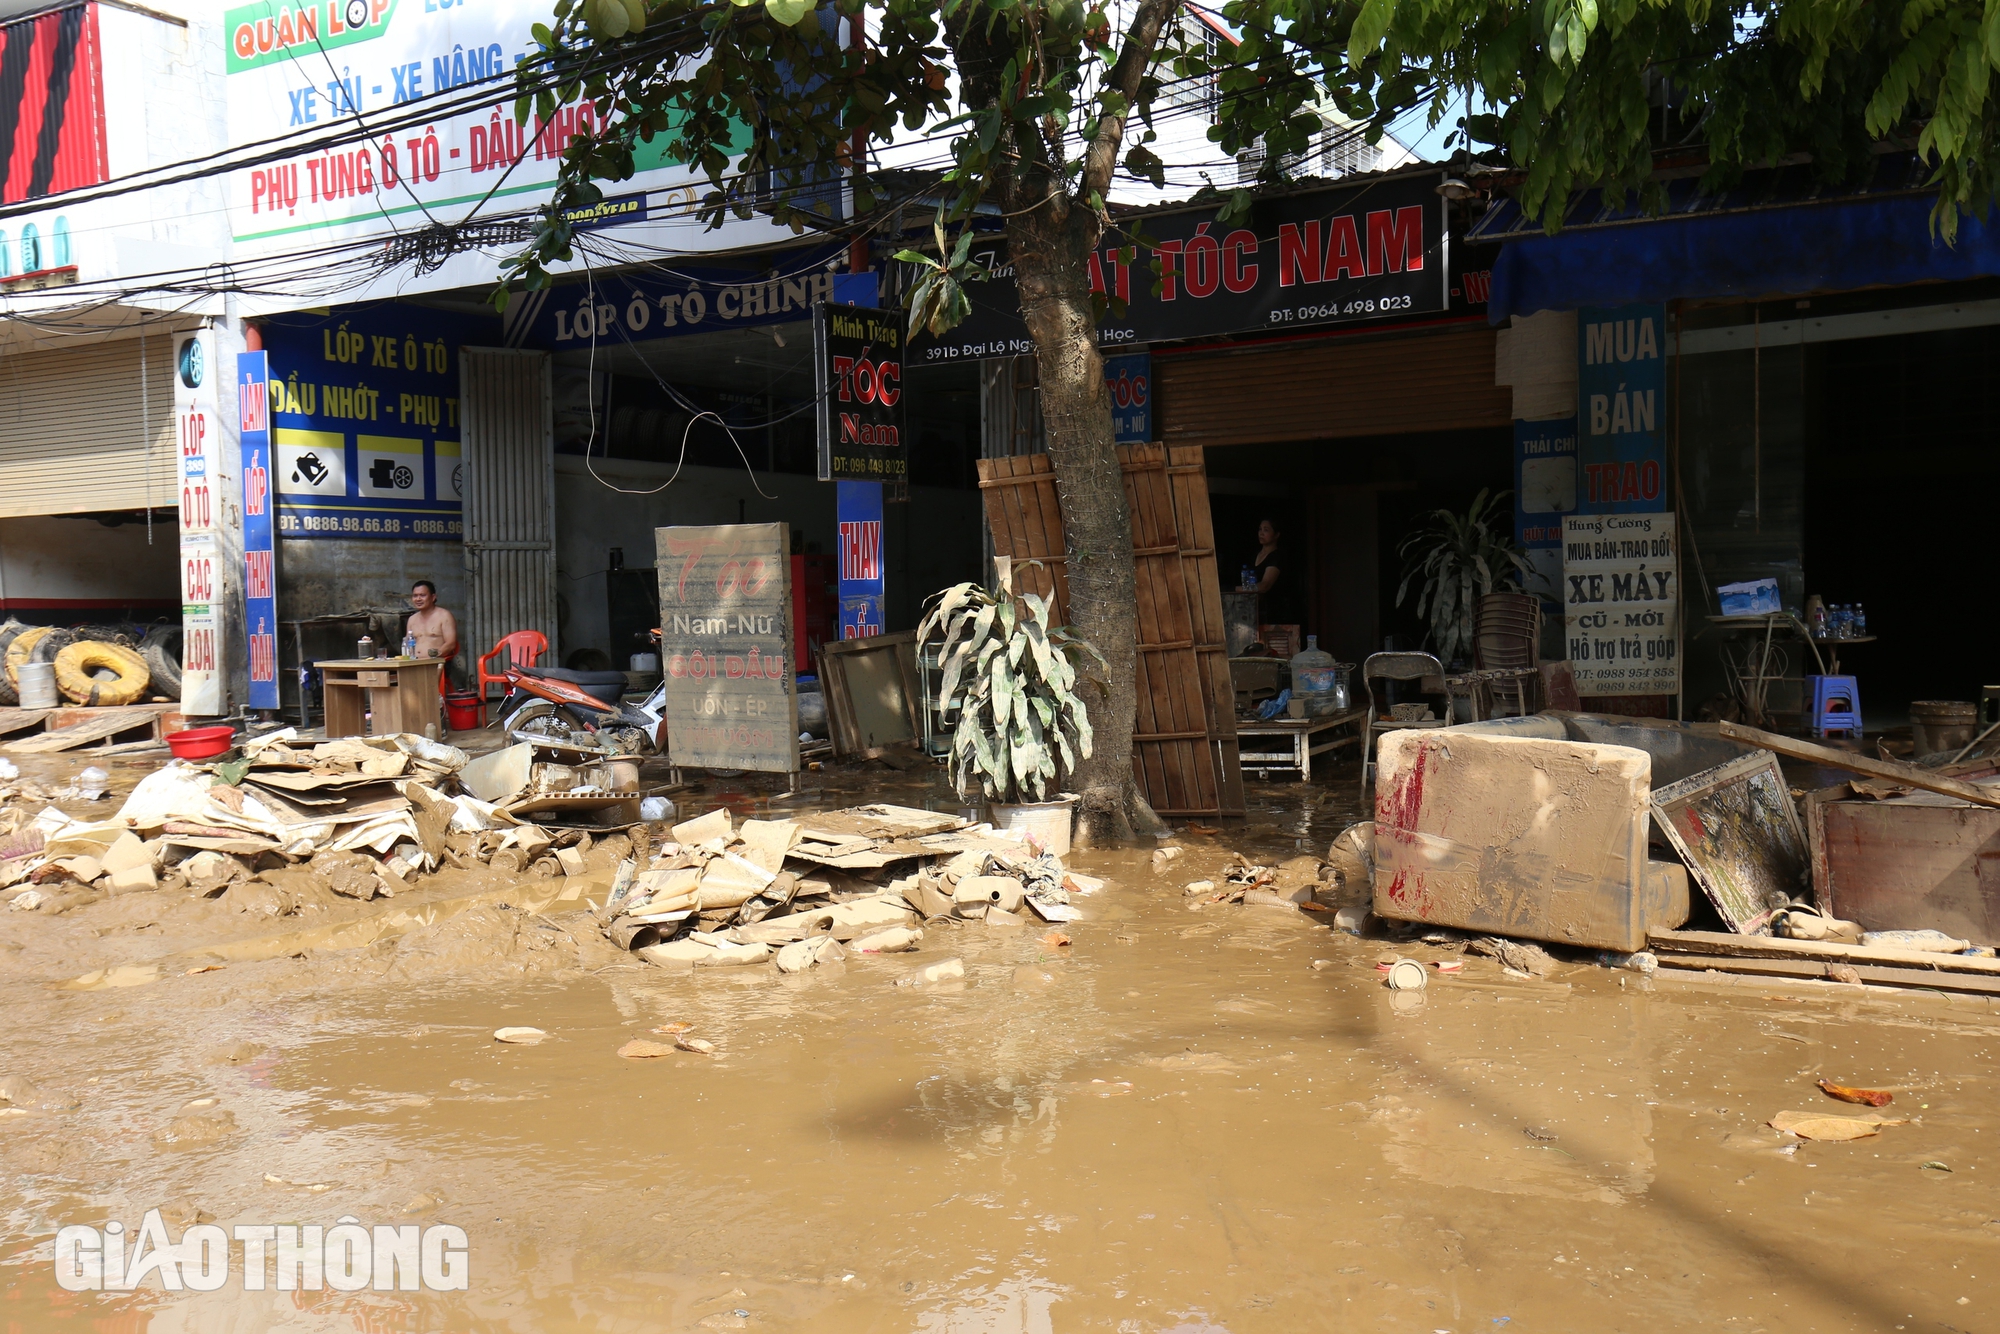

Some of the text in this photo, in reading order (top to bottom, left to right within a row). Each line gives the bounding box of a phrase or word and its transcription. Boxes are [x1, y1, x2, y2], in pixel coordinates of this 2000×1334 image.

[235, 6, 318, 59] QUÂN
[288, 86, 317, 126] XE
[327, 66, 362, 118] TẢI
[391, 61, 423, 104] XE
[433, 43, 503, 93] NÂNG
[251, 163, 298, 216] PHỤ
[306, 148, 373, 203] TÙNG
[381, 134, 398, 189] Ô
[407, 126, 440, 184] TÔ
[469, 105, 524, 173] DẦU
[561, 201, 638, 224] OODYEAR
[1152, 222, 1258, 301] TÓC
[1279, 205, 1423, 287] NAM
[554, 291, 617, 341] LỐP
[626, 290, 650, 332] Ô
[659, 282, 706, 328] TÔ
[716, 270, 834, 320] CHÍNH
[1298, 304, 1338, 320] 0964
[1343, 300, 1375, 314] 498
[1380, 296, 1411, 310] 023
[324, 320, 448, 374] LỐP XE Ô TÔ
[832, 314, 897, 348] Minh Tùng
[926, 347, 959, 359] 391b
[962, 343, 986, 356] Đại
[990, 342, 1005, 354] Lộ
[1104, 328, 1134, 341] Học
[1586, 317, 1658, 365] MUA
[833, 346, 901, 407] TÓC
[240, 373, 266, 432] LÀM
[269, 370, 316, 416] DẦU
[322, 382, 379, 421] NHỚT
[400, 393, 440, 433] PHỤ
[1590, 383, 1655, 435] BÁN
[182, 398, 204, 455] LỐP
[839, 412, 900, 446] Nam
[1523, 434, 1575, 454] THẢI CHÌ
[186, 460, 205, 473] 389
[244, 449, 266, 515] LỐP
[851, 458, 866, 472] 096
[868, 458, 883, 473] 449
[1585, 459, 1660, 503] TRAO
[183, 476, 210, 529] Ô TÔ
[280, 515, 299, 530] ĐT:
[303, 516, 400, 533] 0886.98.66.88
[1523, 525, 1545, 542] HÚT
[1568, 517, 1651, 534] Hùng Cường
[840, 521, 880, 580] THAY
[1568, 543, 1592, 560] MUA
[1651, 532, 1669, 557] ĐỔI
[187, 550, 211, 601] CÁC
[245, 550, 272, 598] THAY
[667, 535, 770, 603] Tóc
[1568, 564, 1672, 603] XE MÁY
[673, 614, 773, 635] Nam-Nữ
[1579, 611, 1607, 628] CŨ
[1624, 609, 1664, 627] MỚI
[187, 629, 214, 680] LOẠI
[249, 617, 273, 682] DẦU
[669, 650, 717, 682] GỘI
[724, 646, 783, 679] ĐẦU
[1570, 632, 1675, 664] Hỗ trợ trả góp
[1596, 682, 1625, 692] 0969
[1653, 680, 1675, 690] 990
[1597, 668, 1625, 679] 0988
[1653, 667, 1675, 677] 858
[746, 694, 767, 717] ÉP
